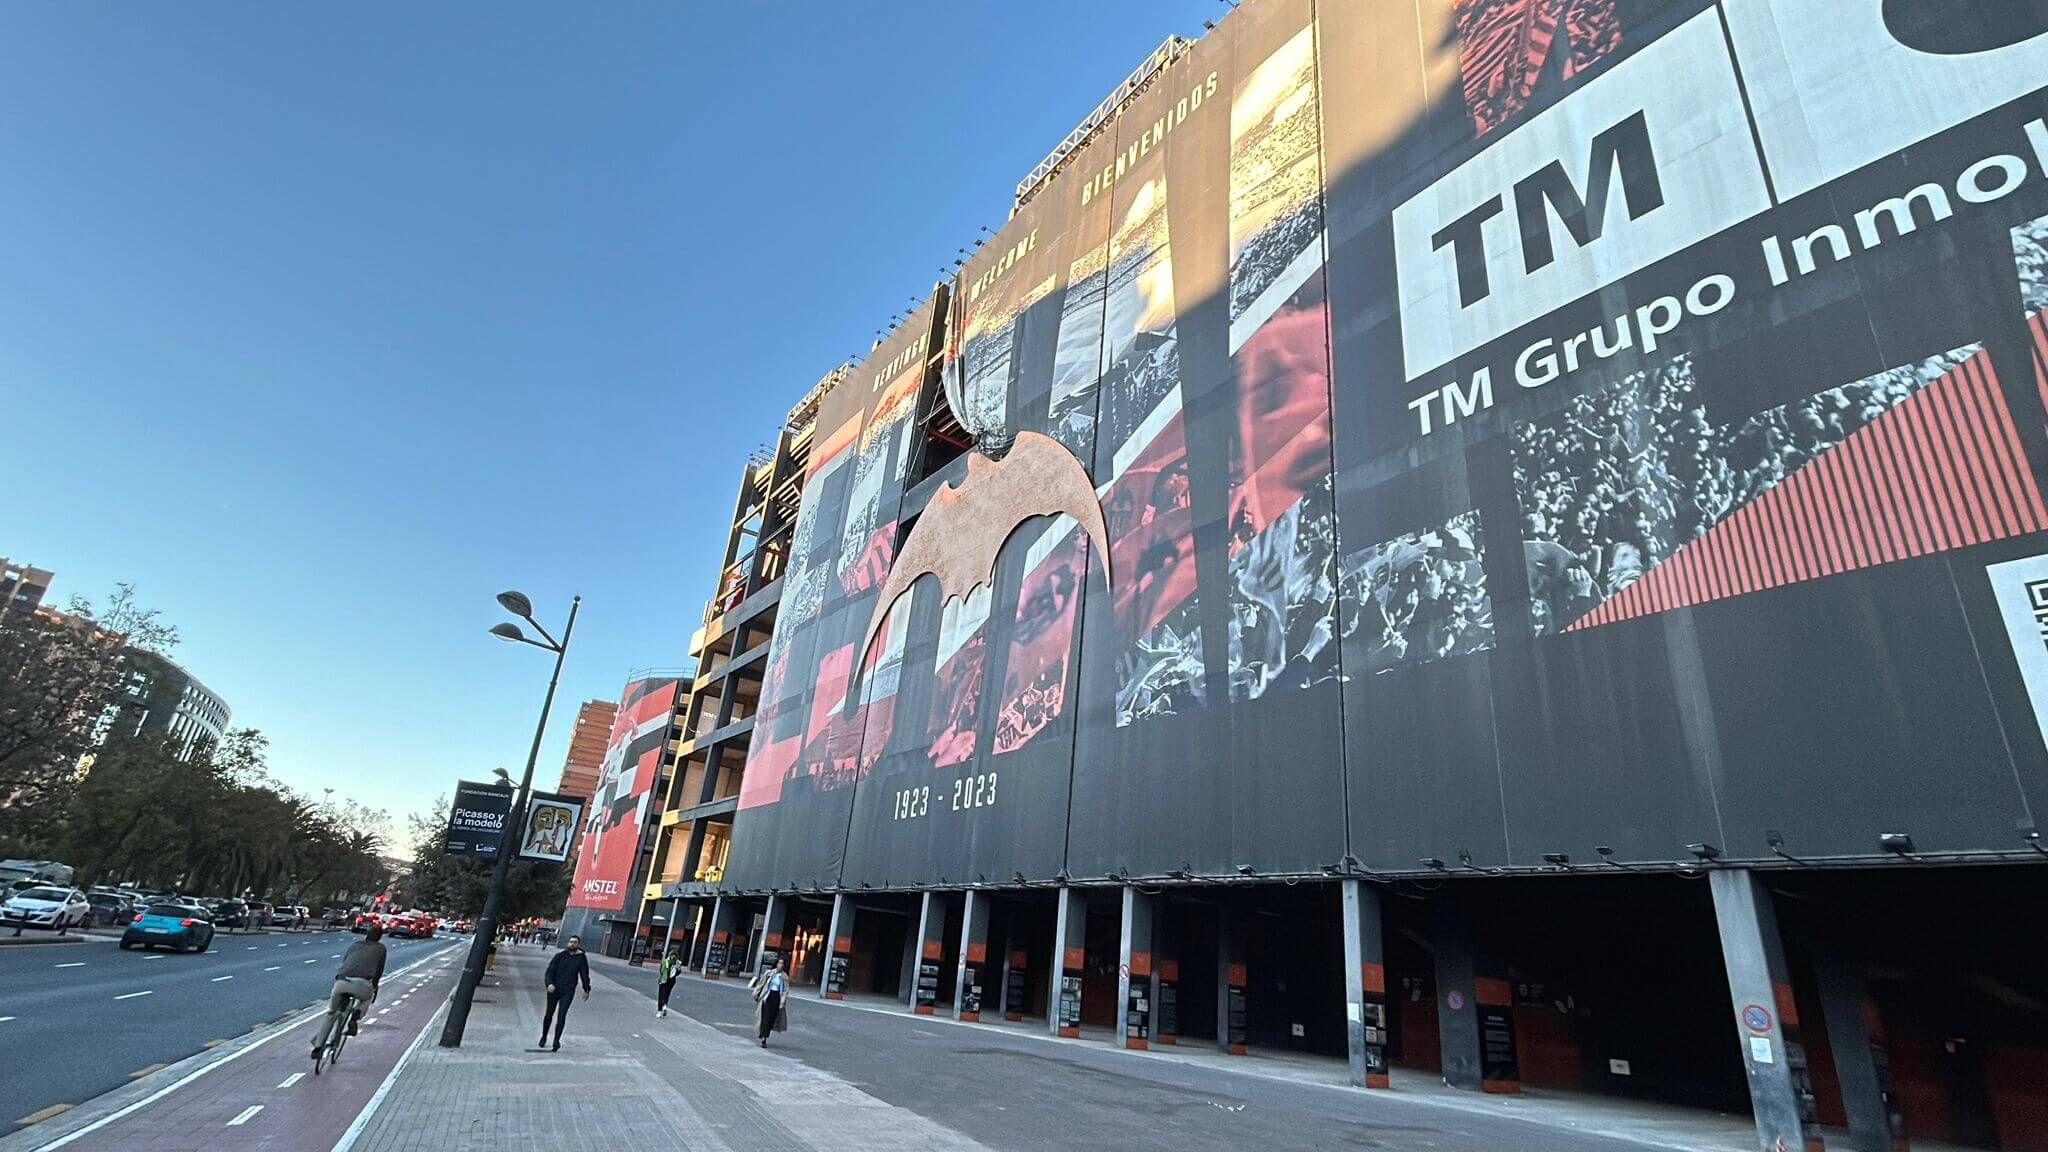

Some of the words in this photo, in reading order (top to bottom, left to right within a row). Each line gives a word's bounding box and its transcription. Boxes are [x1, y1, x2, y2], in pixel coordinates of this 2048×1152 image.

[1082, 71, 1217, 206] BIENVENIDOS
[1431, 109, 1666, 309] TM
[970, 228, 1038, 302] WELCOME
[1408, 366, 1494, 436] TM
[1515, 274, 1736, 388] Grupo
[1762, 117, 2048, 286] Inmo
[453, 816, 462, 825] la
[464, 819, 503, 829] modelo
[455, 808, 495, 820] Picasso
[498, 814, 504, 822] y
[894, 786, 929, 820] 1923
[952, 772, 997, 811] 2023
[583, 879, 618, 895] AMSTEL
